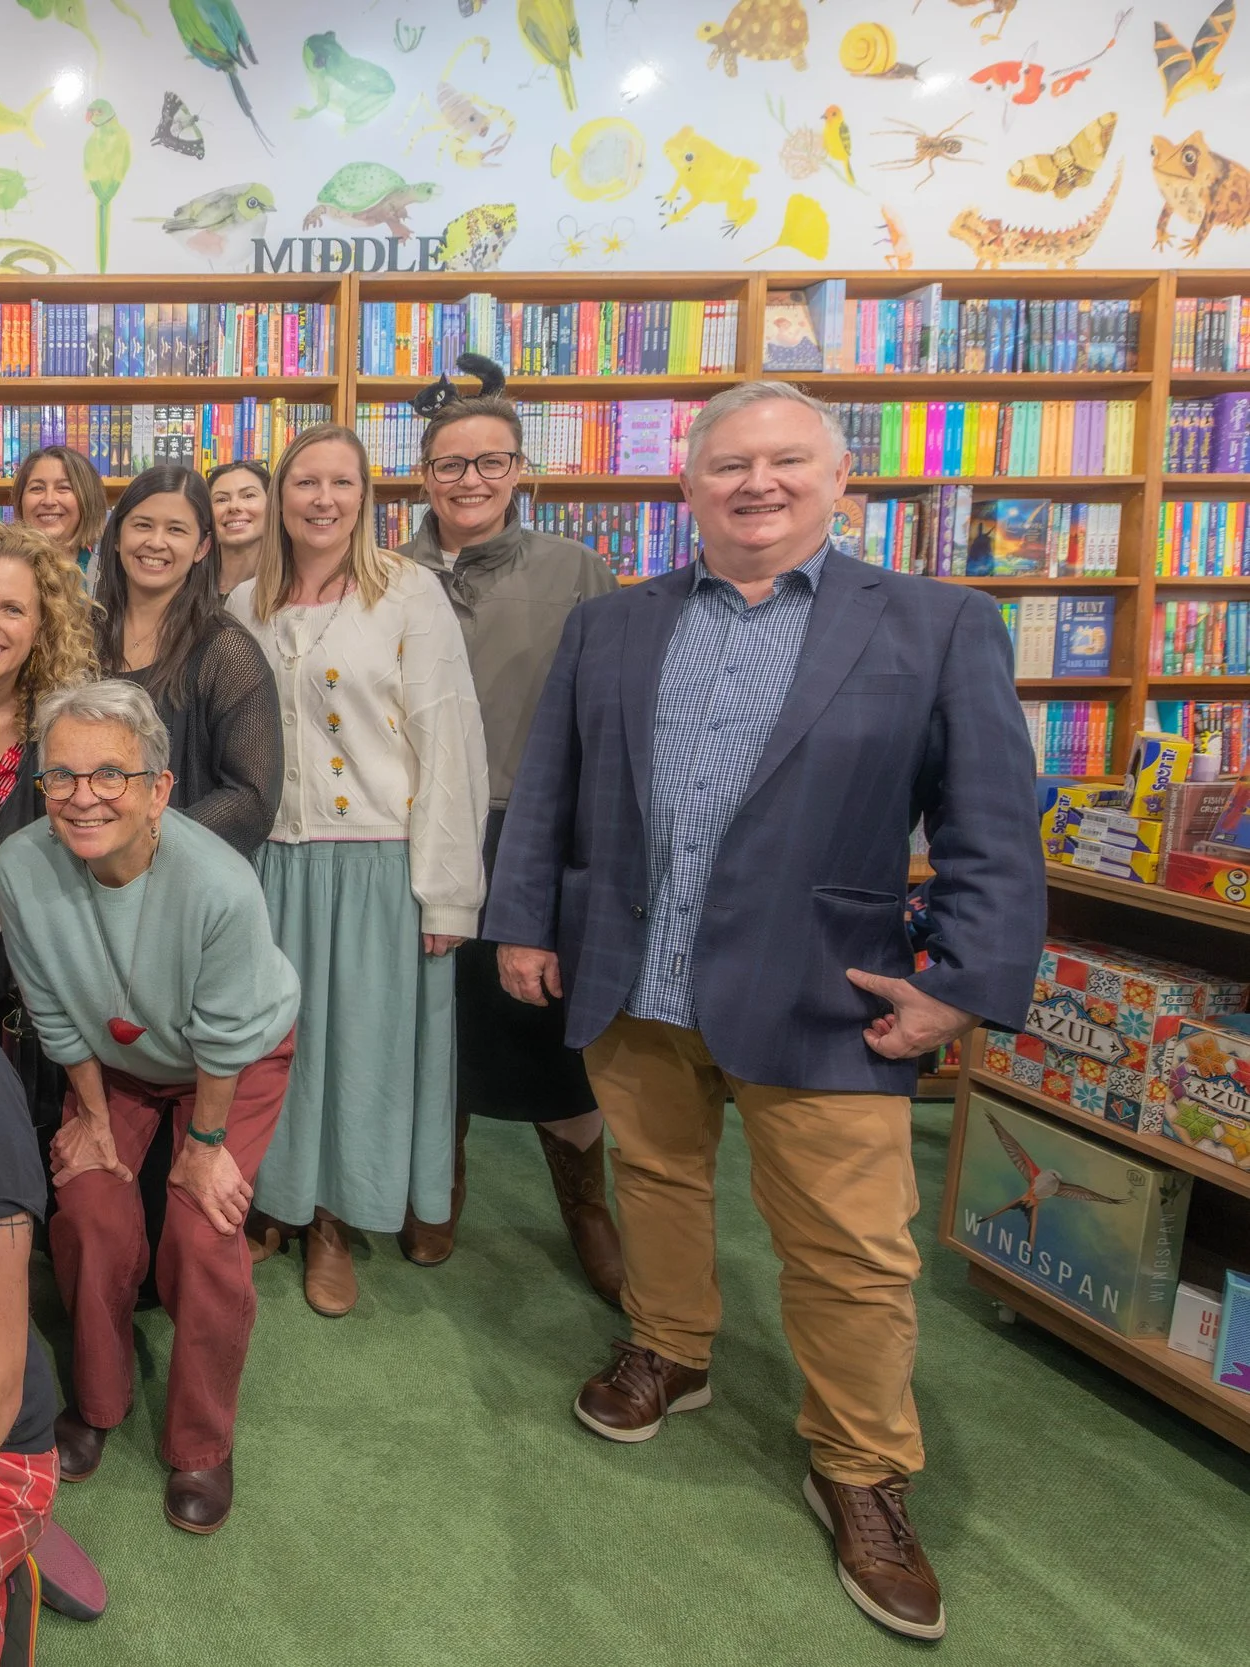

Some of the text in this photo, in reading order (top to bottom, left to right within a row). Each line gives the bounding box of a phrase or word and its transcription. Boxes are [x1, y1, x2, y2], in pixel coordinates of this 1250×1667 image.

[250, 236, 448, 274] MIDDLE
[1076, 601, 1105, 613] RUNT
[1203, 796, 1225, 805] FISHY
[1026, 1008, 1104, 1052] AZUL
[1193, 1083, 1250, 1113] AZUL
[964, 1208, 1120, 1314] WINGSPAN
[1149, 1212, 1177, 1303] WINGSPAN
